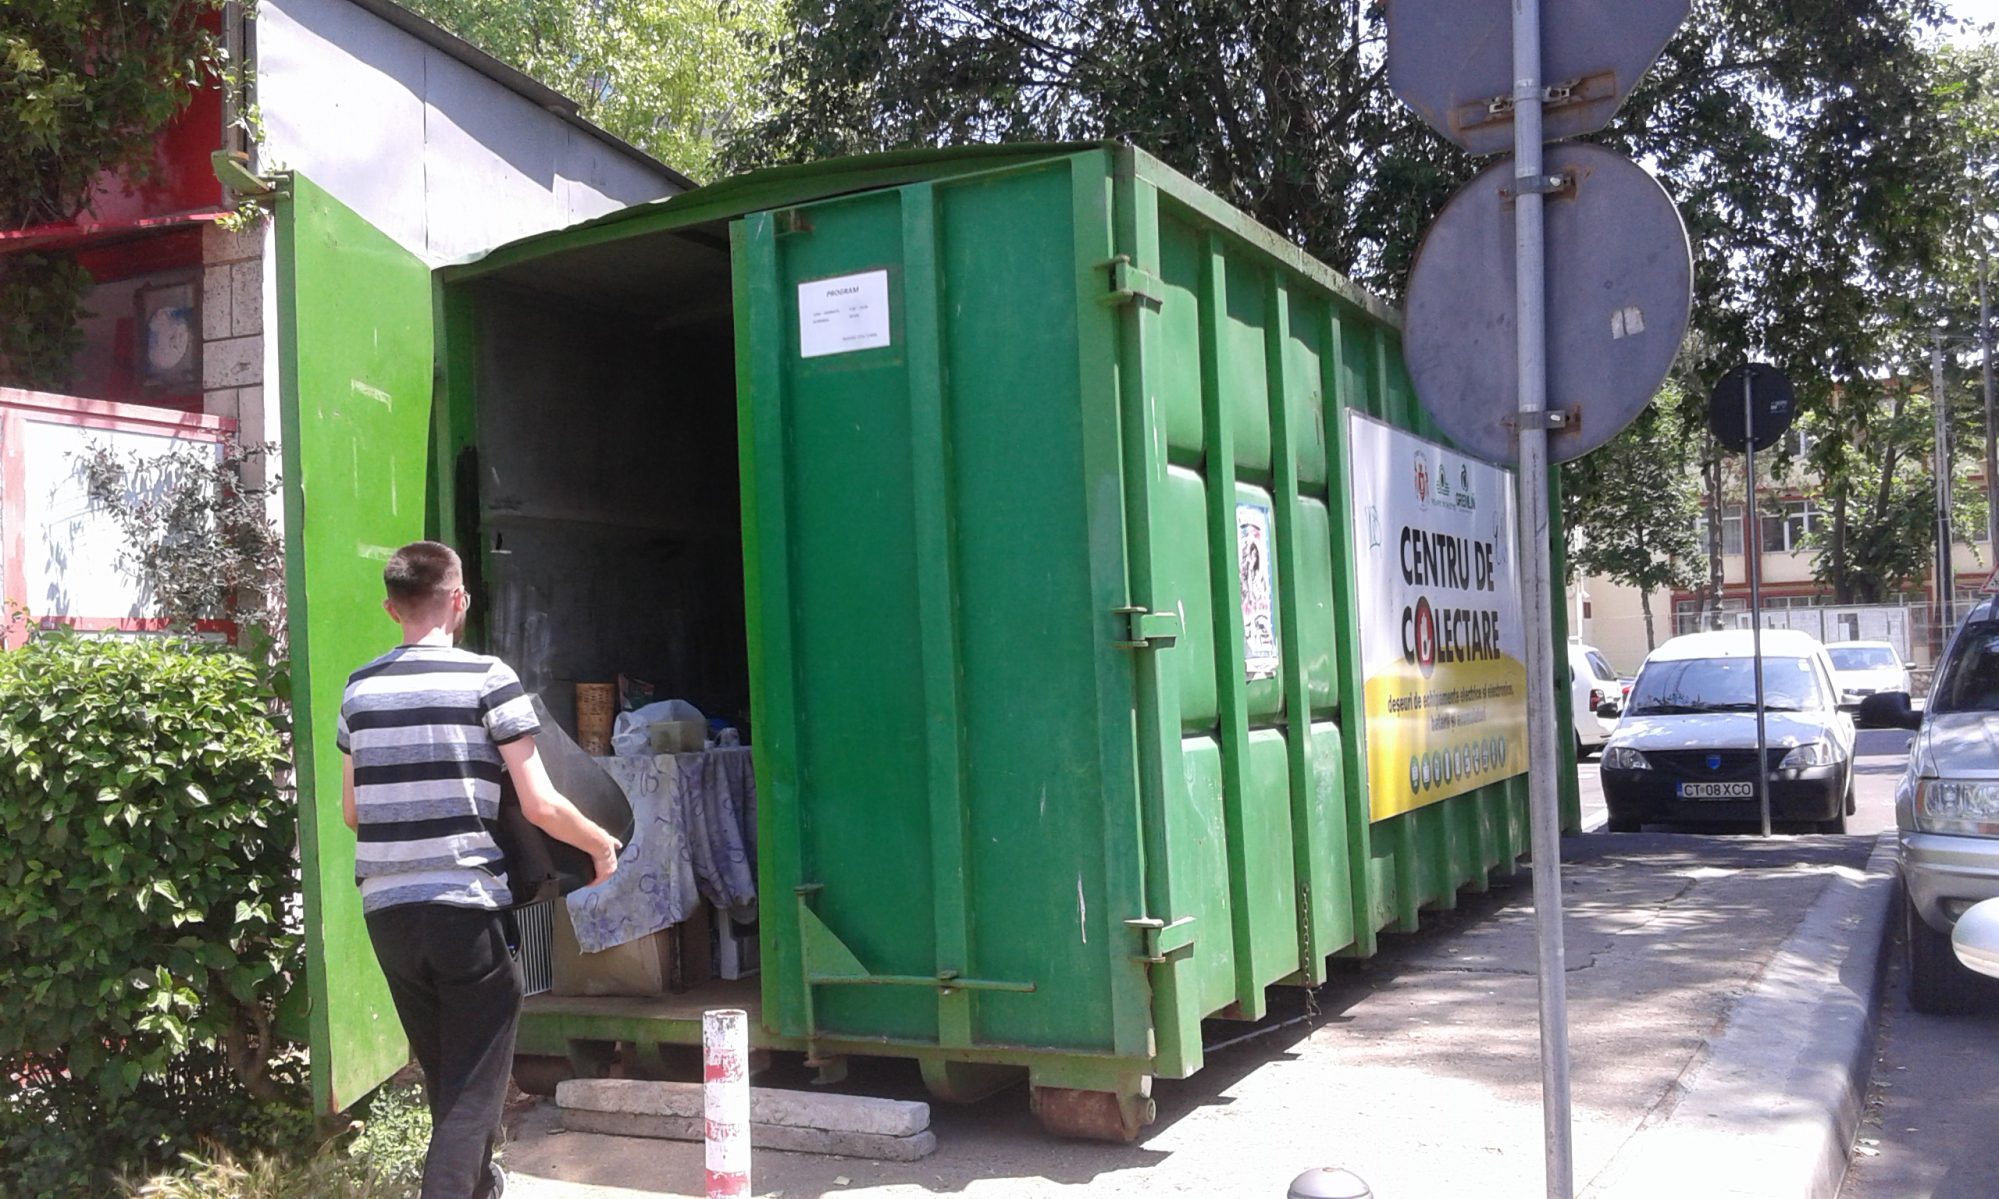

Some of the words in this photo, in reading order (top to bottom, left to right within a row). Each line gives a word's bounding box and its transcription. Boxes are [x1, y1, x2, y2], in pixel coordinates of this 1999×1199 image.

[826, 286, 859, 297] PROGRAM
[1400, 526, 1470, 590] CENTRU
[1474, 541, 1495, 591] DE
[1402, 596, 1500, 679] COLECTARE
[1414, 691, 1422, 710] de
[1684, 784, 1701, 796] CT
[1706, 784, 1722, 796] 08
[1723, 784, 1752, 796] XCO
